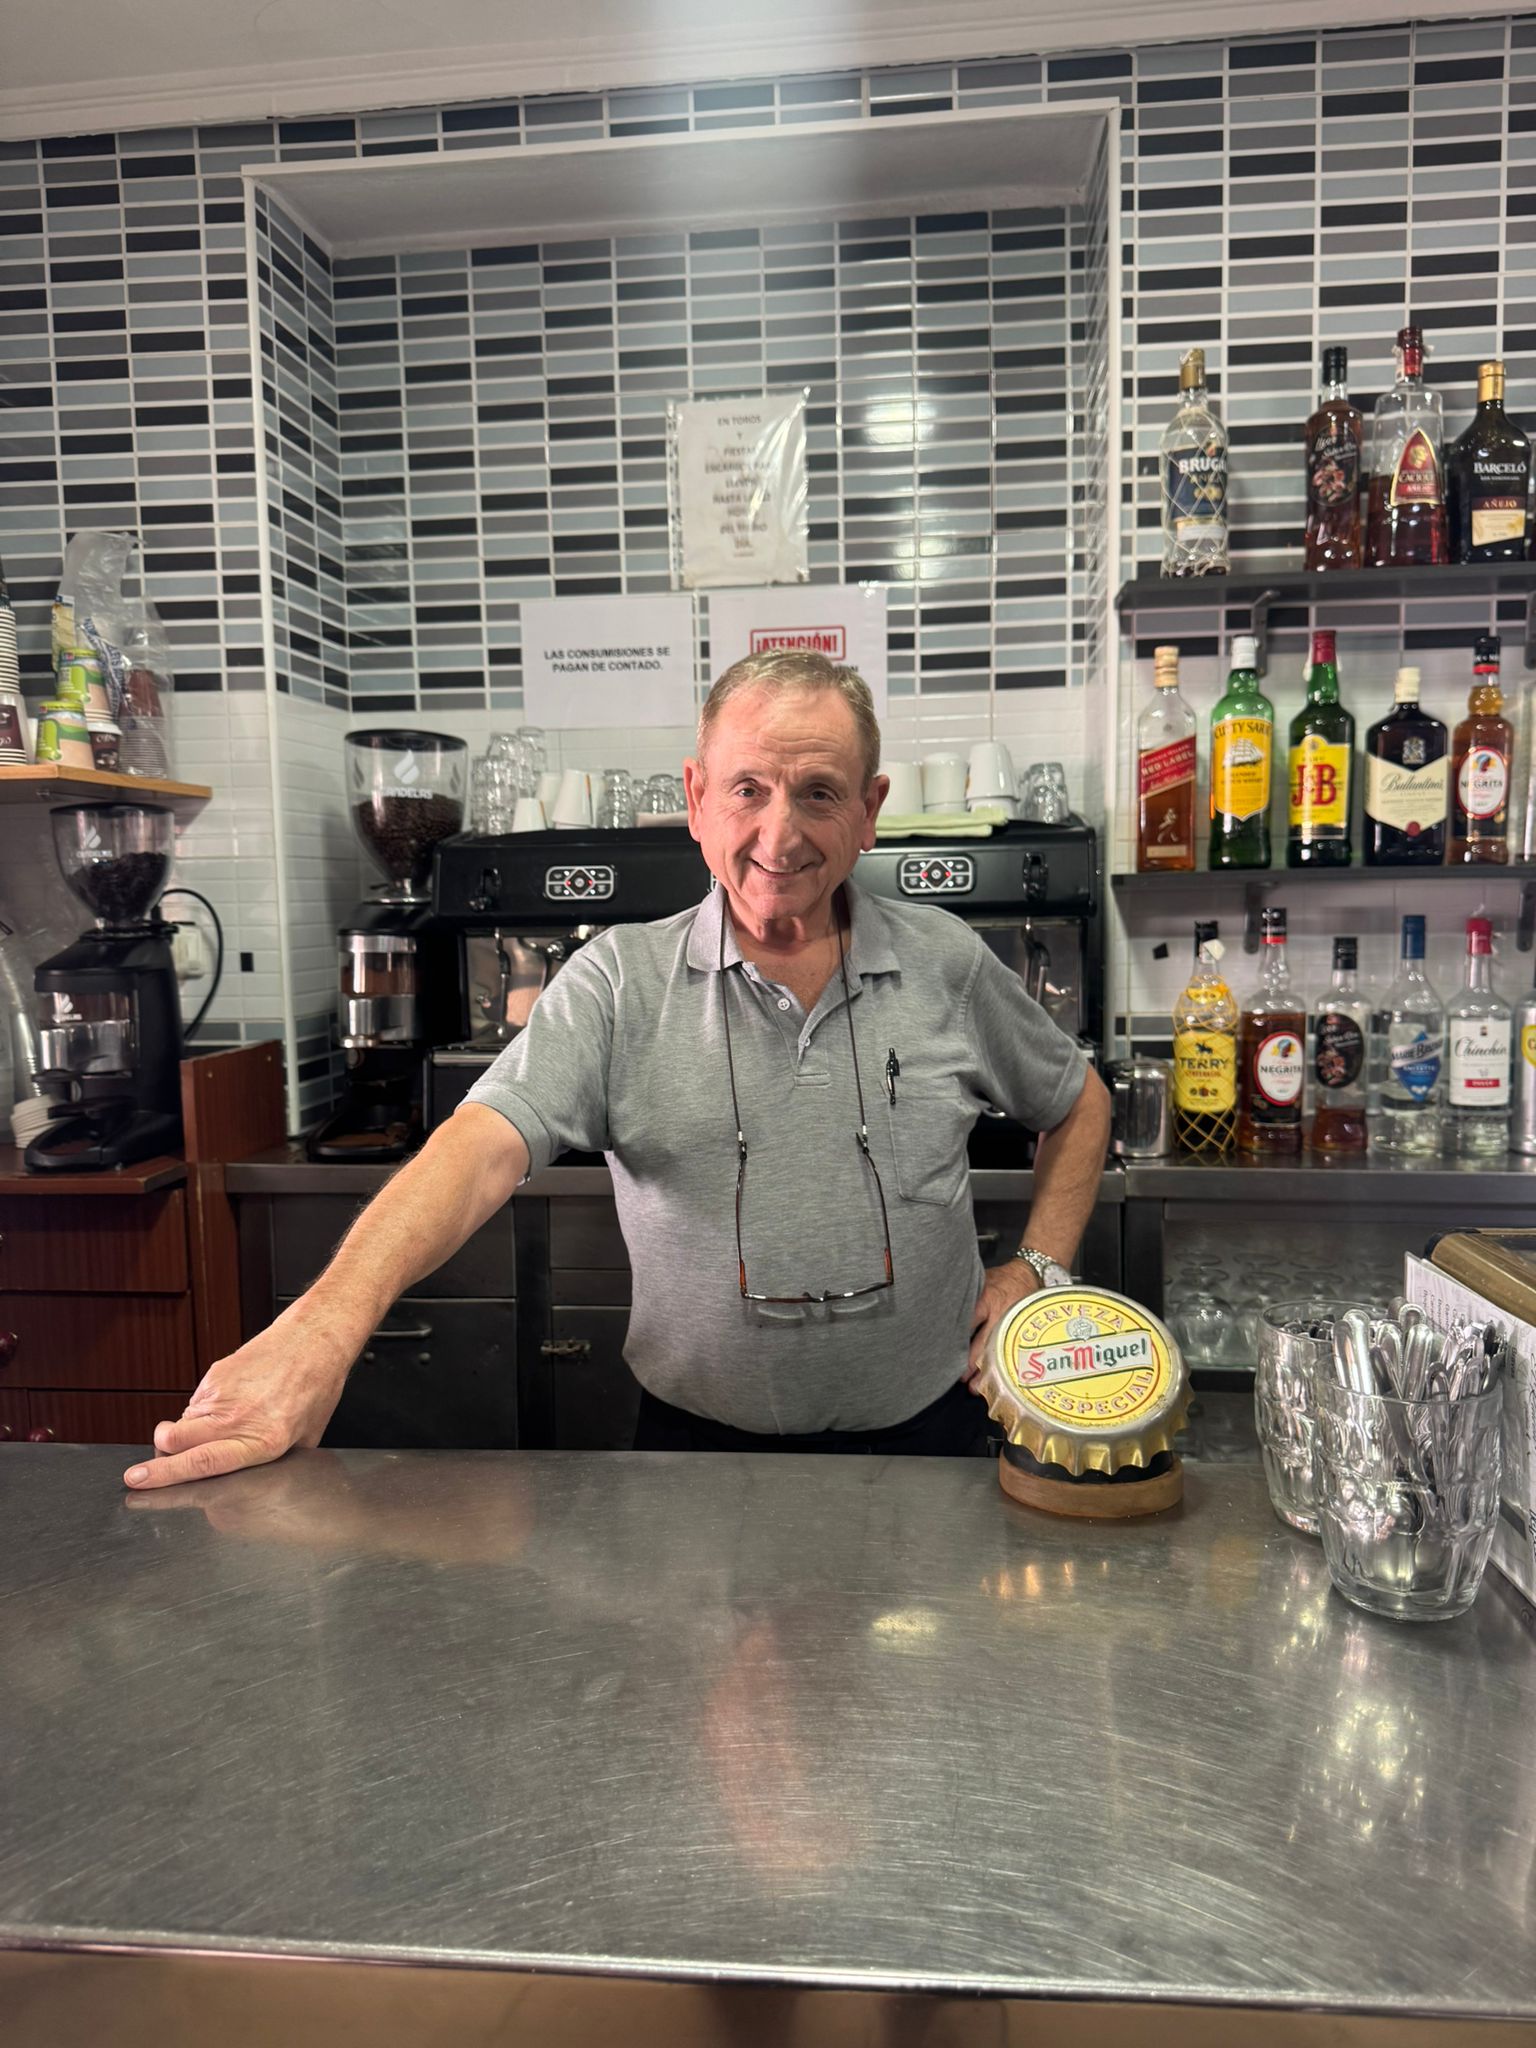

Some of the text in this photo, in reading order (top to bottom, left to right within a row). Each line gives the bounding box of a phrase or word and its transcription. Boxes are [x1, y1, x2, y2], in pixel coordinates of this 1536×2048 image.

[1473, 461, 1527, 475] BARCELÓ
[1483, 498, 1518, 508] AÑEJO
[756, 632, 838, 653] ¡ATENCIÓN!
[544, 646, 671, 660] LAS CONSUMISIONES SE
[552, 660, 663, 673] PAGAN DE CONTADO.
[1141, 761, 1161, 777] RED
[1163, 750, 1195, 768] LABEL
[1179, 1057, 1229, 1071] TERRY
[1022, 1304, 1124, 1342] CERVEZA
[1043, 1371, 1154, 1414] ESPECIAL
